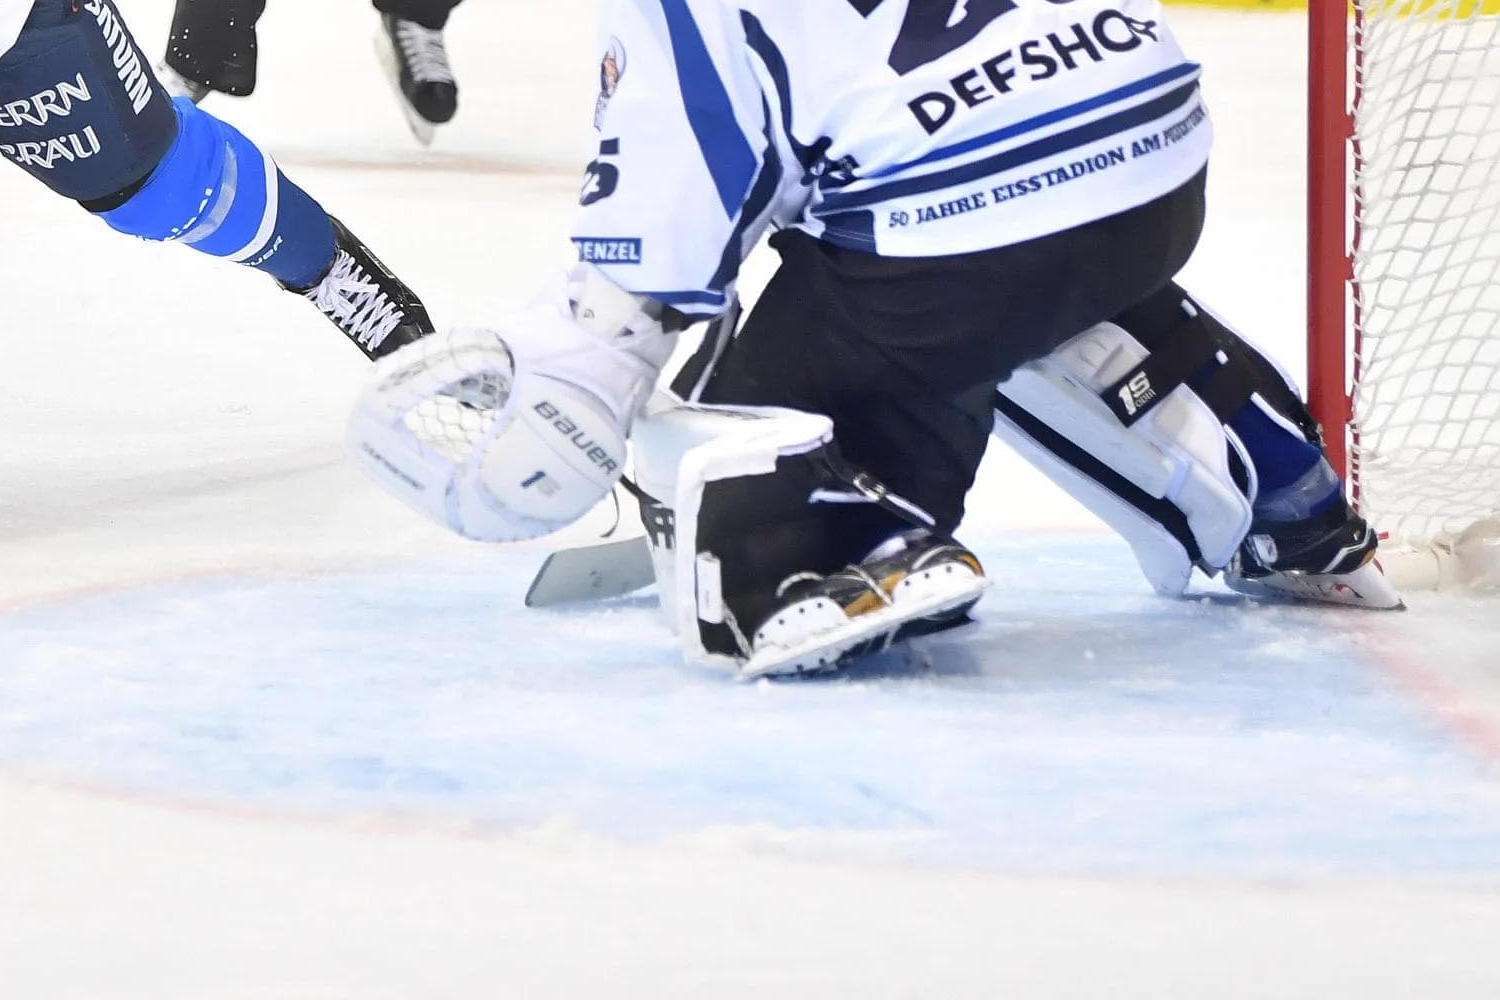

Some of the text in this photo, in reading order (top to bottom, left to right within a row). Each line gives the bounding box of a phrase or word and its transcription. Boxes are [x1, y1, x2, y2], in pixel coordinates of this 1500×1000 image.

[915, 191, 986, 225] JAHRE
[991, 145, 1125, 204] EISSTADION
[1131, 134, 1161, 158] AM
[533, 400, 617, 475] BAUER
